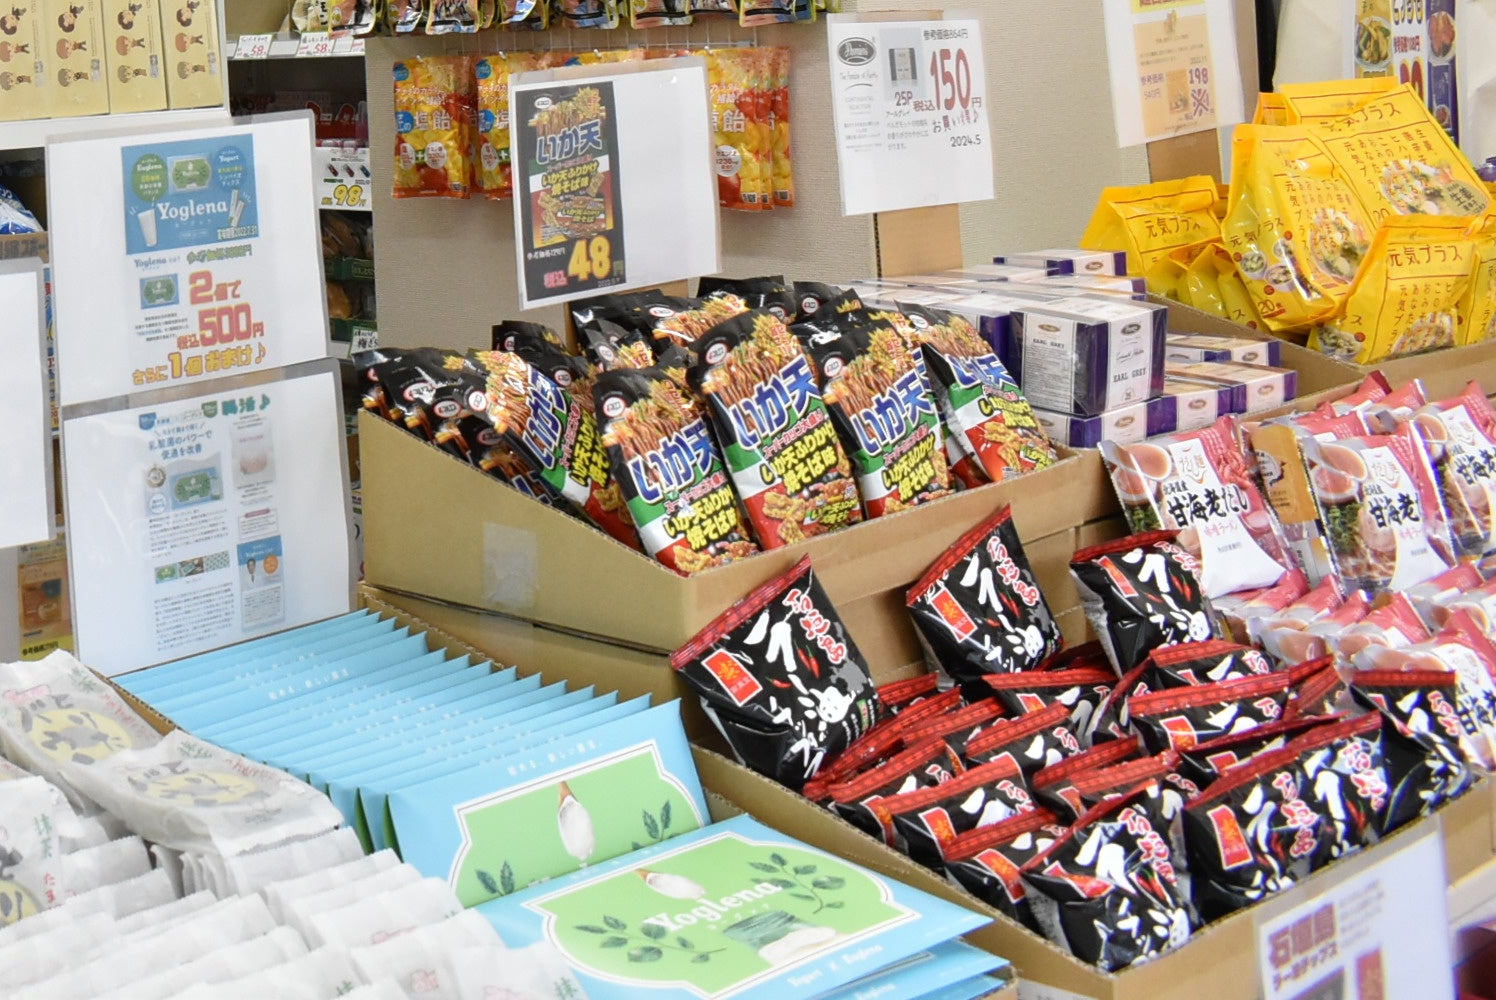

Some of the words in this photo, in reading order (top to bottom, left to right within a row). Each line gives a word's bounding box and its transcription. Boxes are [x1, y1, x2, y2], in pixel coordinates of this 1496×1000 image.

[913, 48, 982, 112] 税込150円
[1189, 67, 1209, 85] 198
[894, 90, 914, 107] 25P
[536, 118, 603, 166] いか天
[950, 135, 982, 148] 2024.5
[541, 160, 600, 187] いか天ふりかけ
[156, 199, 228, 223] Yoglena
[1144, 213, 1202, 240] 元気プラス
[133, 256, 167, 269] Yoglena
[1387, 243, 1464, 268] 元気プラス
[188, 269, 242, 306] 2個で
[176, 302, 265, 350] 税込500円
[1113, 370, 1129, 384] EARL
[1131, 366, 1147, 380] GREY
[729, 353, 822, 451] いか天
[850, 366, 933, 457] いか天
[628, 419, 721, 506] いか天
[782, 445, 837, 496] 焼そば味
[1167, 483, 1250, 528] 甘海老だし
[782, 588, 847, 665] 石垣島
[642, 879, 784, 933] Yoglena
